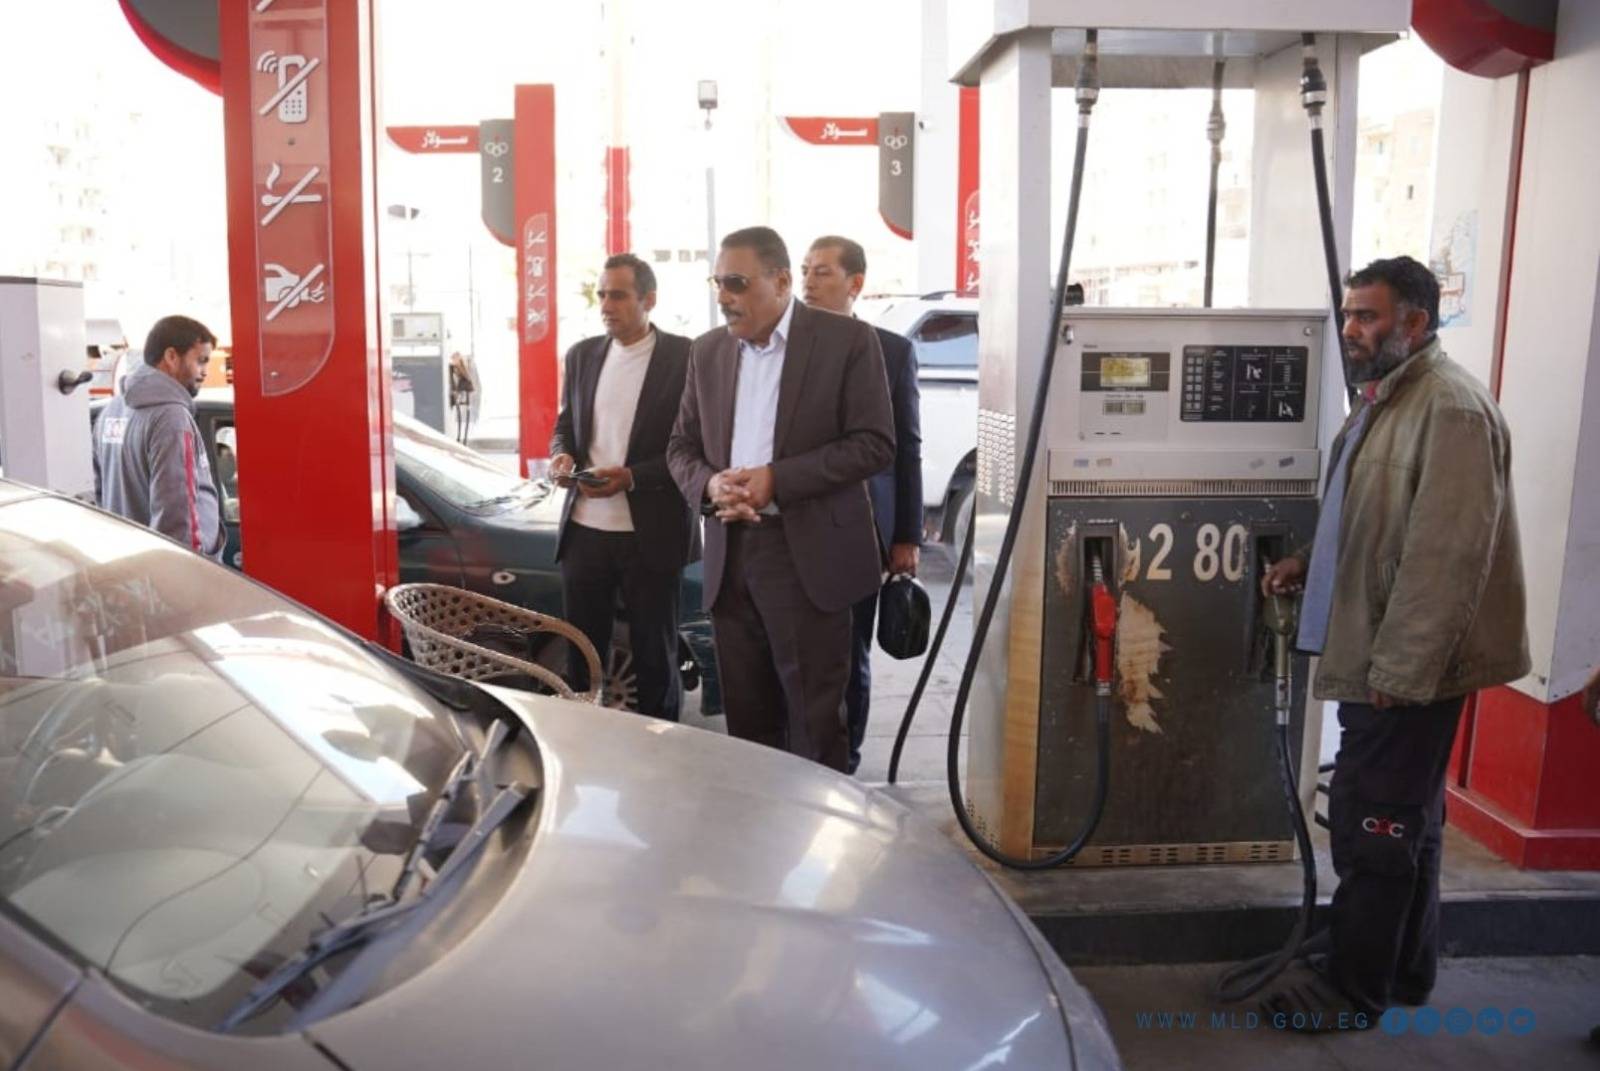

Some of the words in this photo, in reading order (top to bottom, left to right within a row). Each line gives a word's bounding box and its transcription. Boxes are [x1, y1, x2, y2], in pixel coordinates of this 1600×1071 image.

[420, 130, 469, 149] سولار
[820, 122, 868, 141] سولار
[492, 167, 504, 183] 2
[890, 160, 902, 176] 3
[1193, 522, 1247, 582] 80
